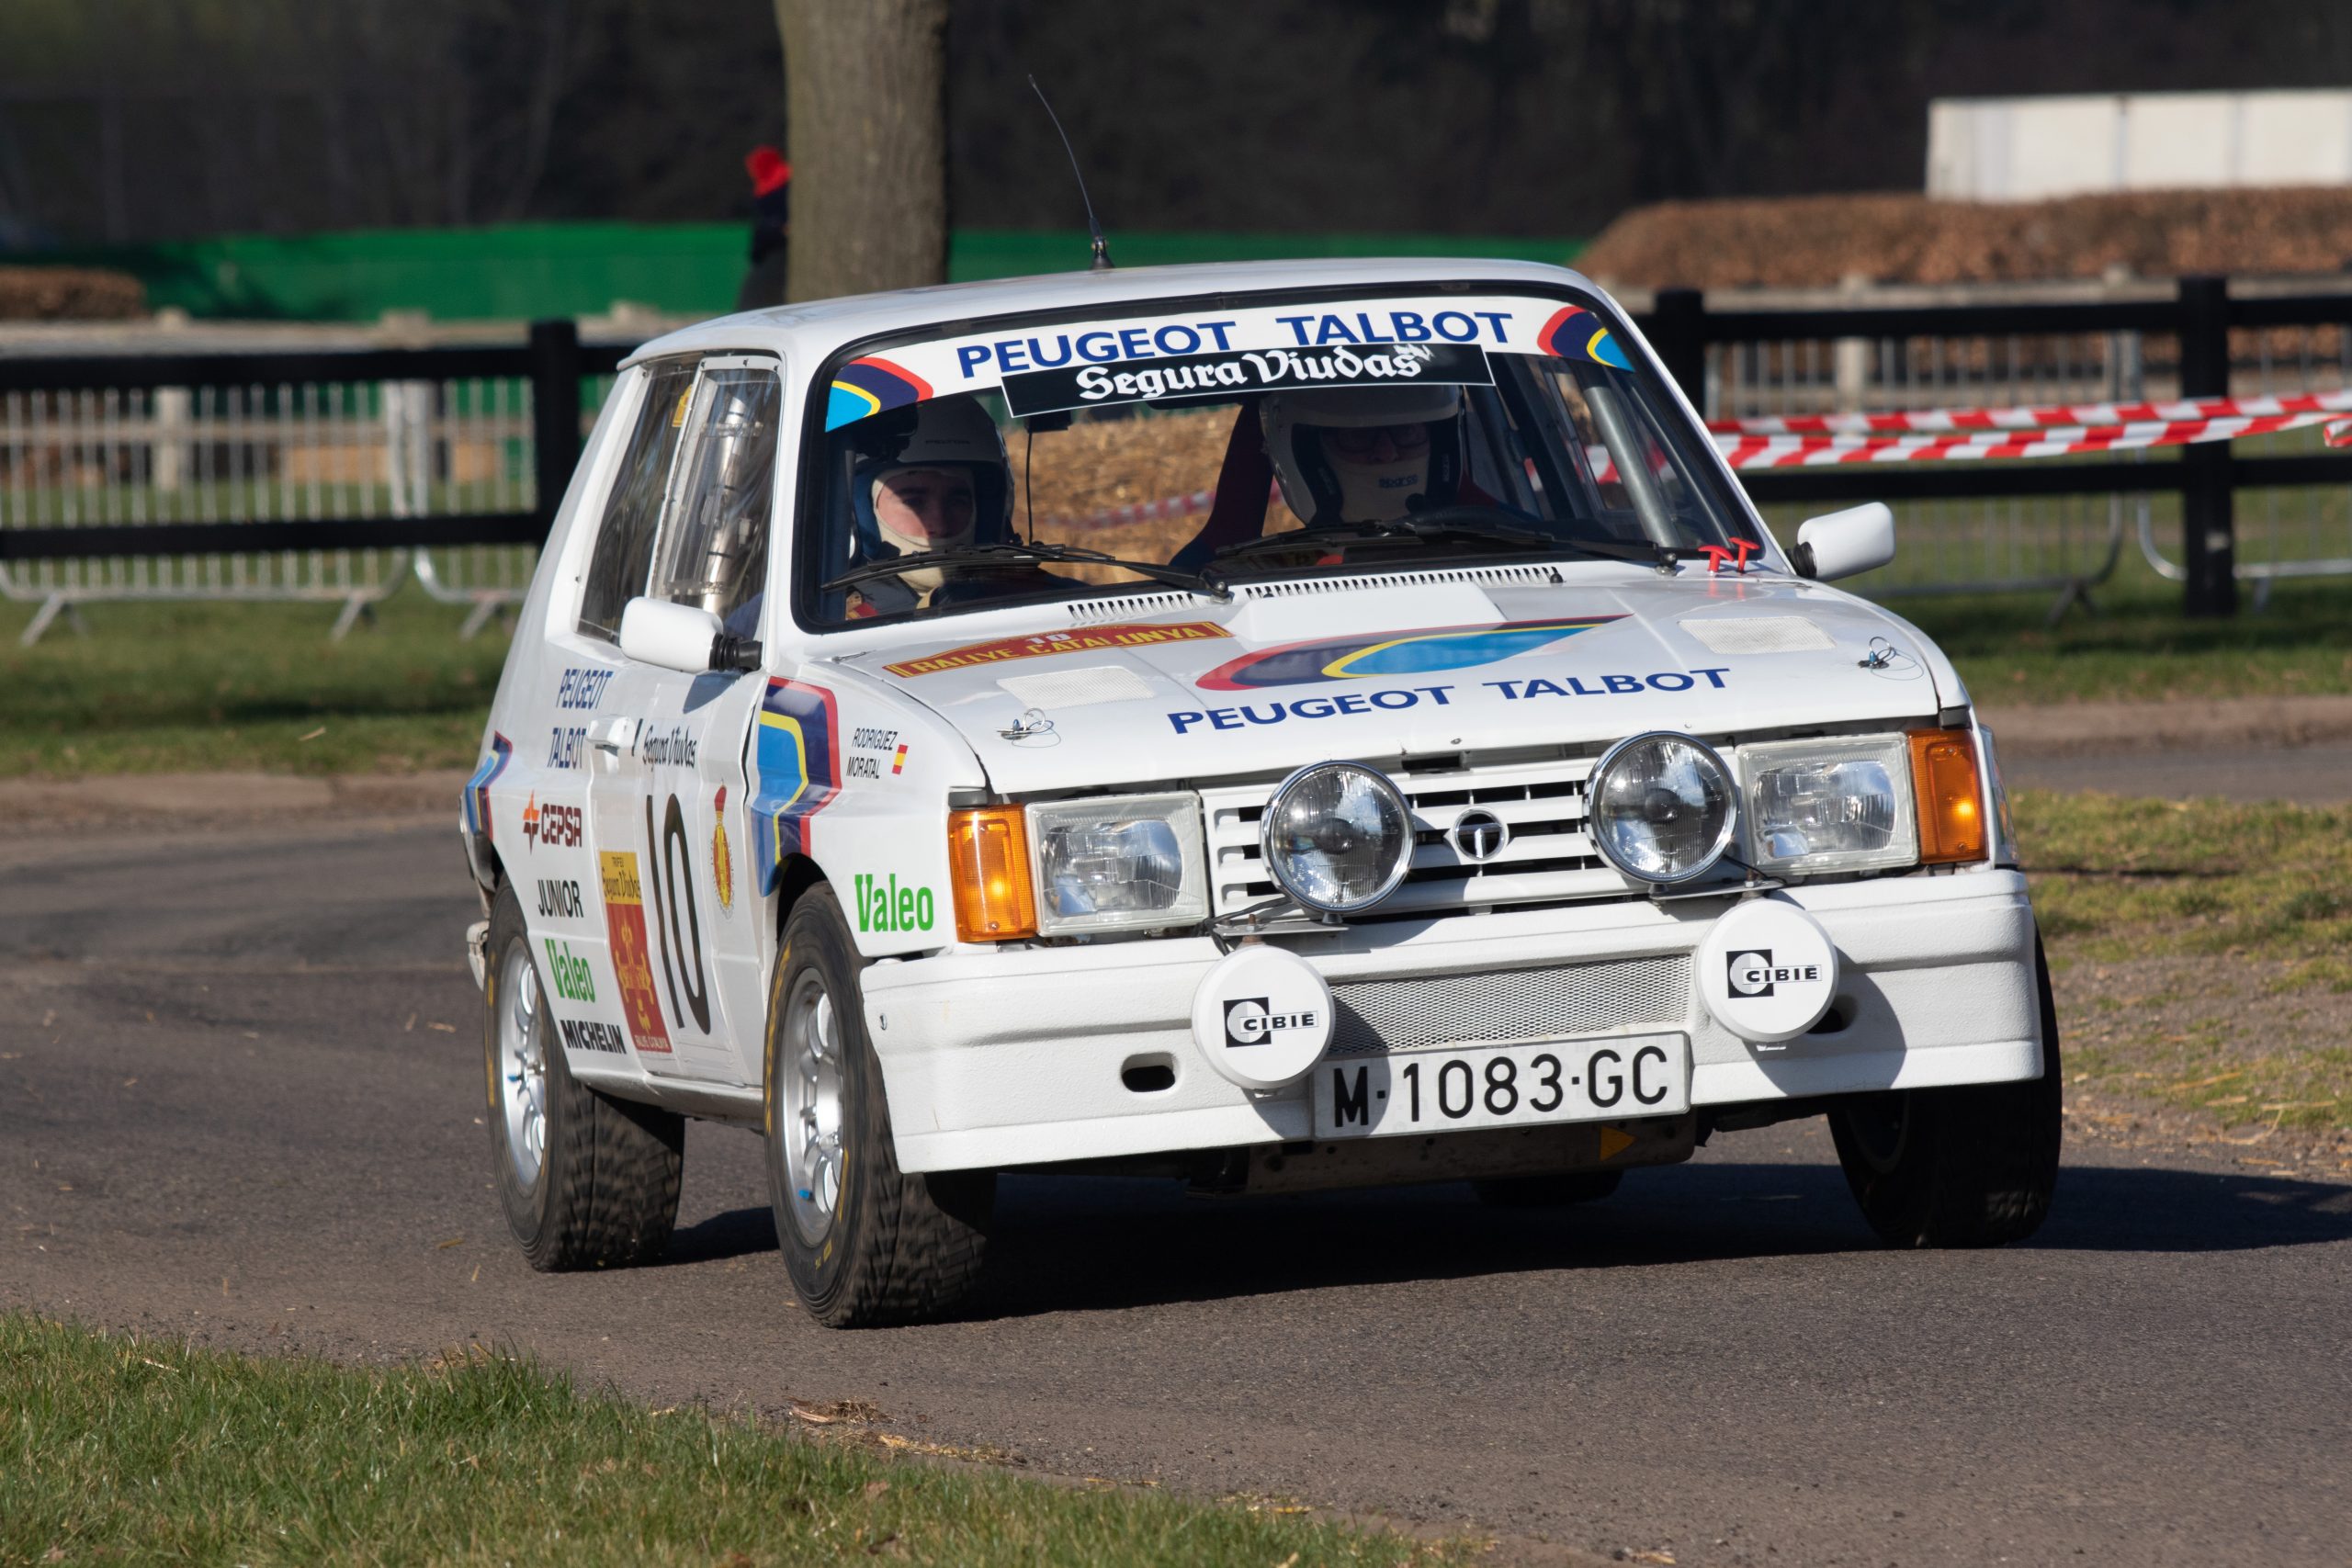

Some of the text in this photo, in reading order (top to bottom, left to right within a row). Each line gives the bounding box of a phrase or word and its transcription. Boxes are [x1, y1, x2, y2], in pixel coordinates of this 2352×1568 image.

[956, 310, 1513, 378] PEUGEOT TALBOT
[1075, 345, 1422, 400] Segura Viudas
[909, 626, 1206, 673] RALLYE CATALUNYA
[1025, 633, 1072, 645] 10
[556, 669, 614, 709] PEUGEOT
[1167, 668, 1731, 735] PEUGEOT TALBOT
[547, 728, 587, 769] TALBOT
[642, 724, 697, 772] Segura Viudas
[852, 728, 899, 751] RODRIGUEZ
[846, 756, 880, 779] MORATAL
[541, 803, 582, 848] CEPSA
[537, 879, 584, 918] JUNIOR
[646, 794, 711, 1035] 10
[854, 874, 934, 932] Valeo
[545, 938, 596, 1003] Valeo
[560, 1020, 627, 1055] MICHELIN
